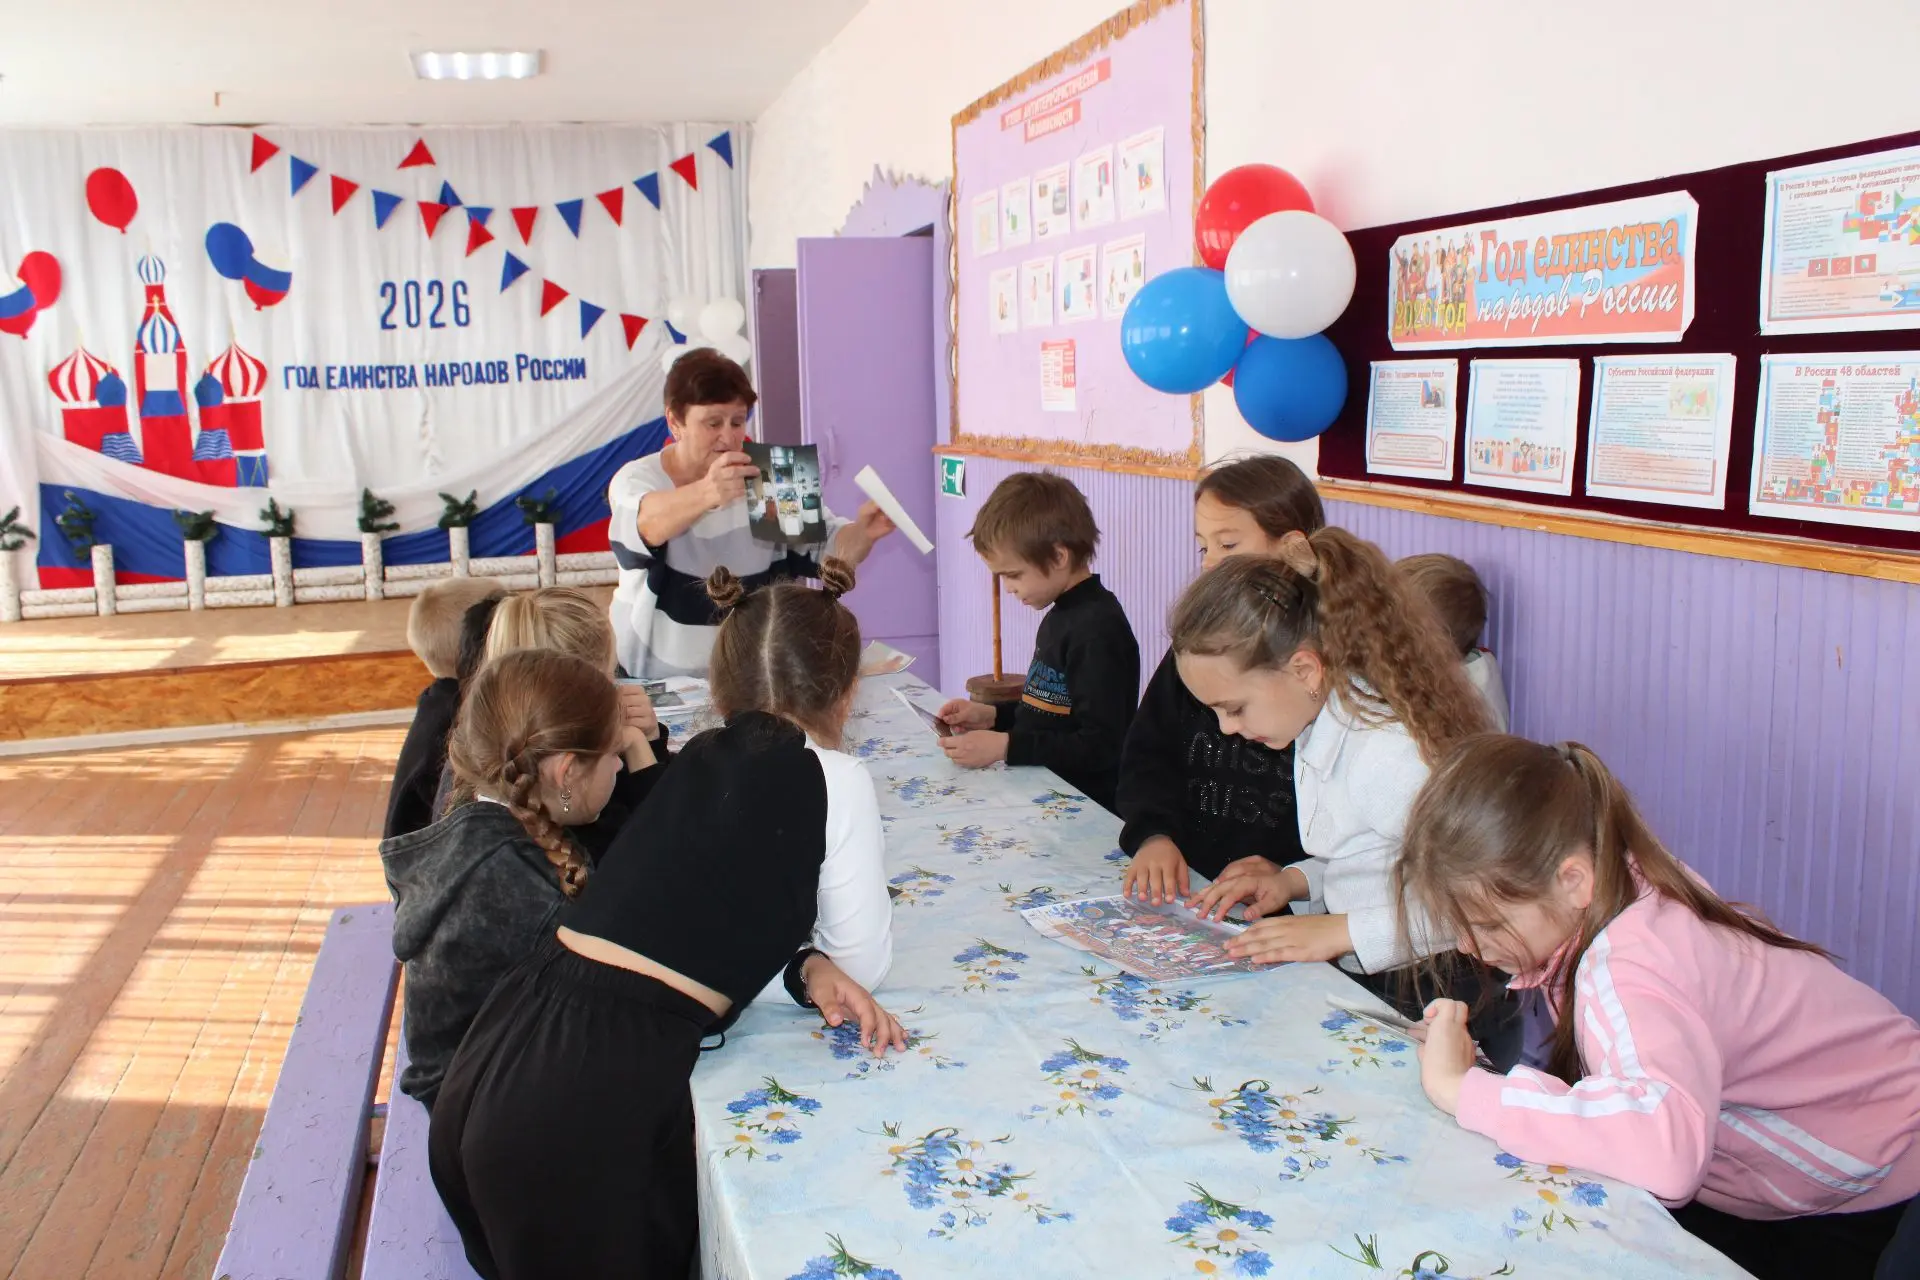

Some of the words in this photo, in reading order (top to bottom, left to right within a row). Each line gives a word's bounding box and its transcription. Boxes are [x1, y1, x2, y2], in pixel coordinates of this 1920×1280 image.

[1478, 230, 1528, 285] Год
[1534, 219, 1681, 283] единства
[379, 279, 471, 331] 2026
[1394, 298, 1432, 331] 2026
[1434, 299, 1467, 336] год
[1477, 272, 1571, 335] народов
[1581, 268, 1679, 318] России
[283, 365, 320, 390] ГОД
[325, 364, 418, 390] ЕДИНСТВА
[424, 359, 510, 387] НАРОДОВ
[1795, 367, 1802, 376] В
[1804, 366, 1837, 376] России
[1840, 365, 1852, 376] 48
[1855, 364, 1901, 376] областей
